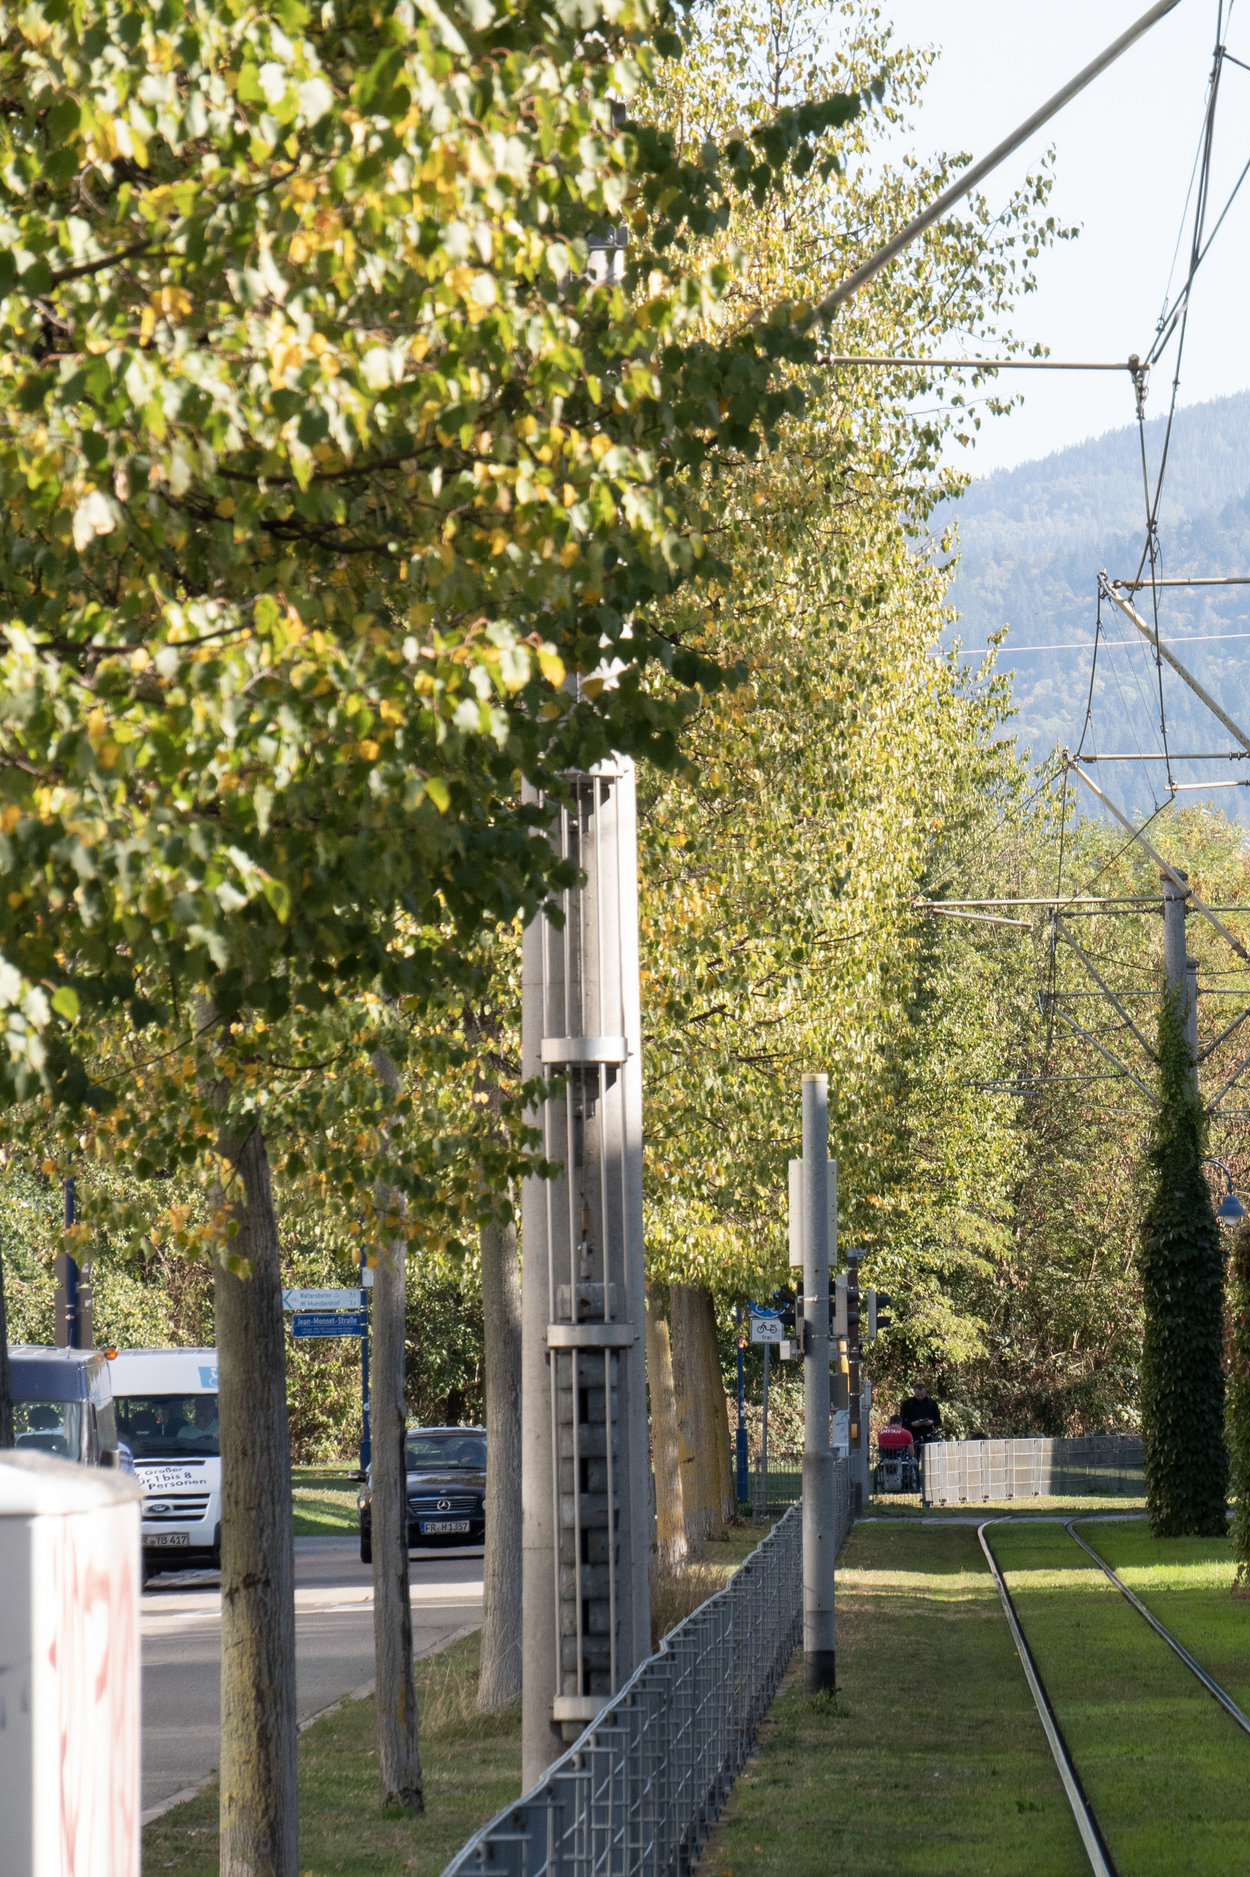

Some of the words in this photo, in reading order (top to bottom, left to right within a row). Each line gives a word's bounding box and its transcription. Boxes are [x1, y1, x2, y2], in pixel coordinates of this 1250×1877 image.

[297, 1317, 357, 1325] Jean-Monnet-Straße
[145, 1467, 183, 1475] Großer
[148, 1479, 207, 1490] Personen
[425, 1523, 436, 1532] FR
[170, 1535, 187, 1545] 417
